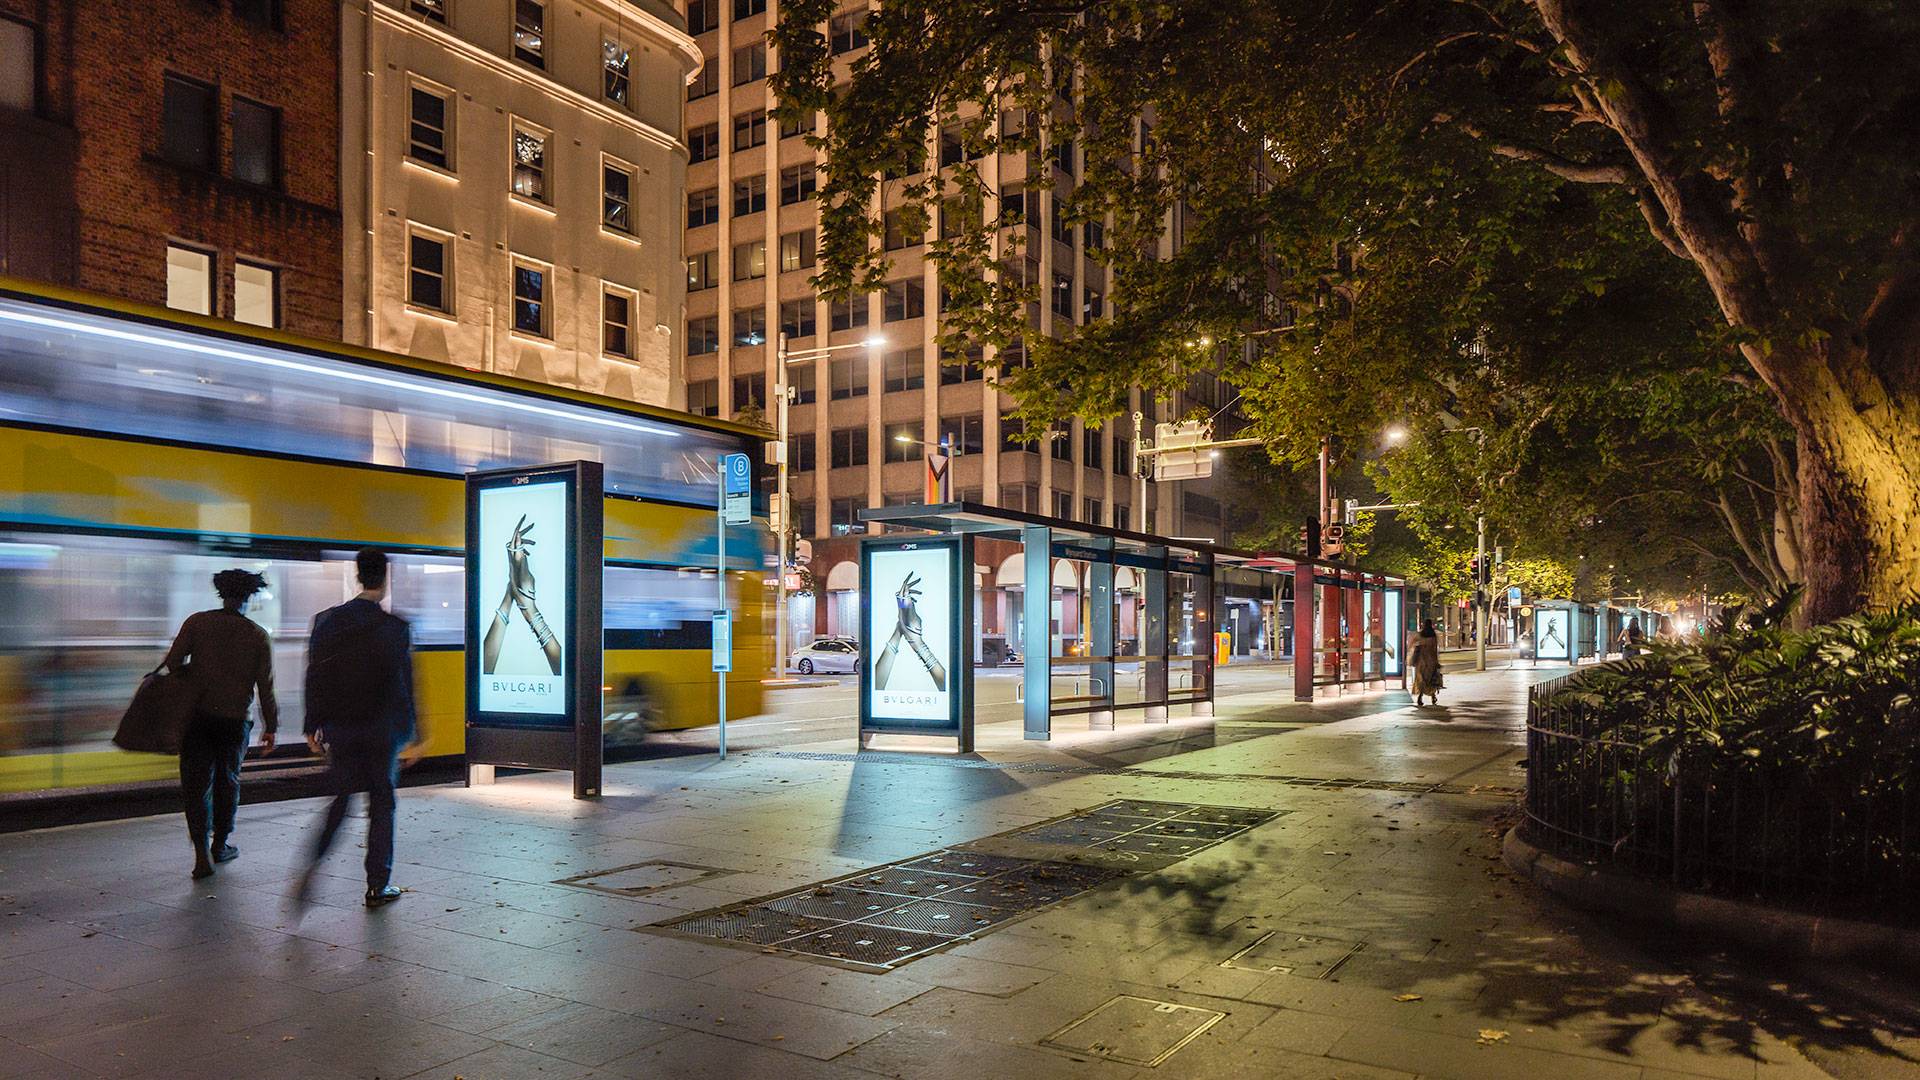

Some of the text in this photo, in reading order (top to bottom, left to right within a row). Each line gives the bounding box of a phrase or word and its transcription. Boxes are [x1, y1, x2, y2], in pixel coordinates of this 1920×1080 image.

[737, 460, 745, 473] B
[492, 681, 552, 693] BVLGARI
[883, 695, 937, 705] BVLGARI
